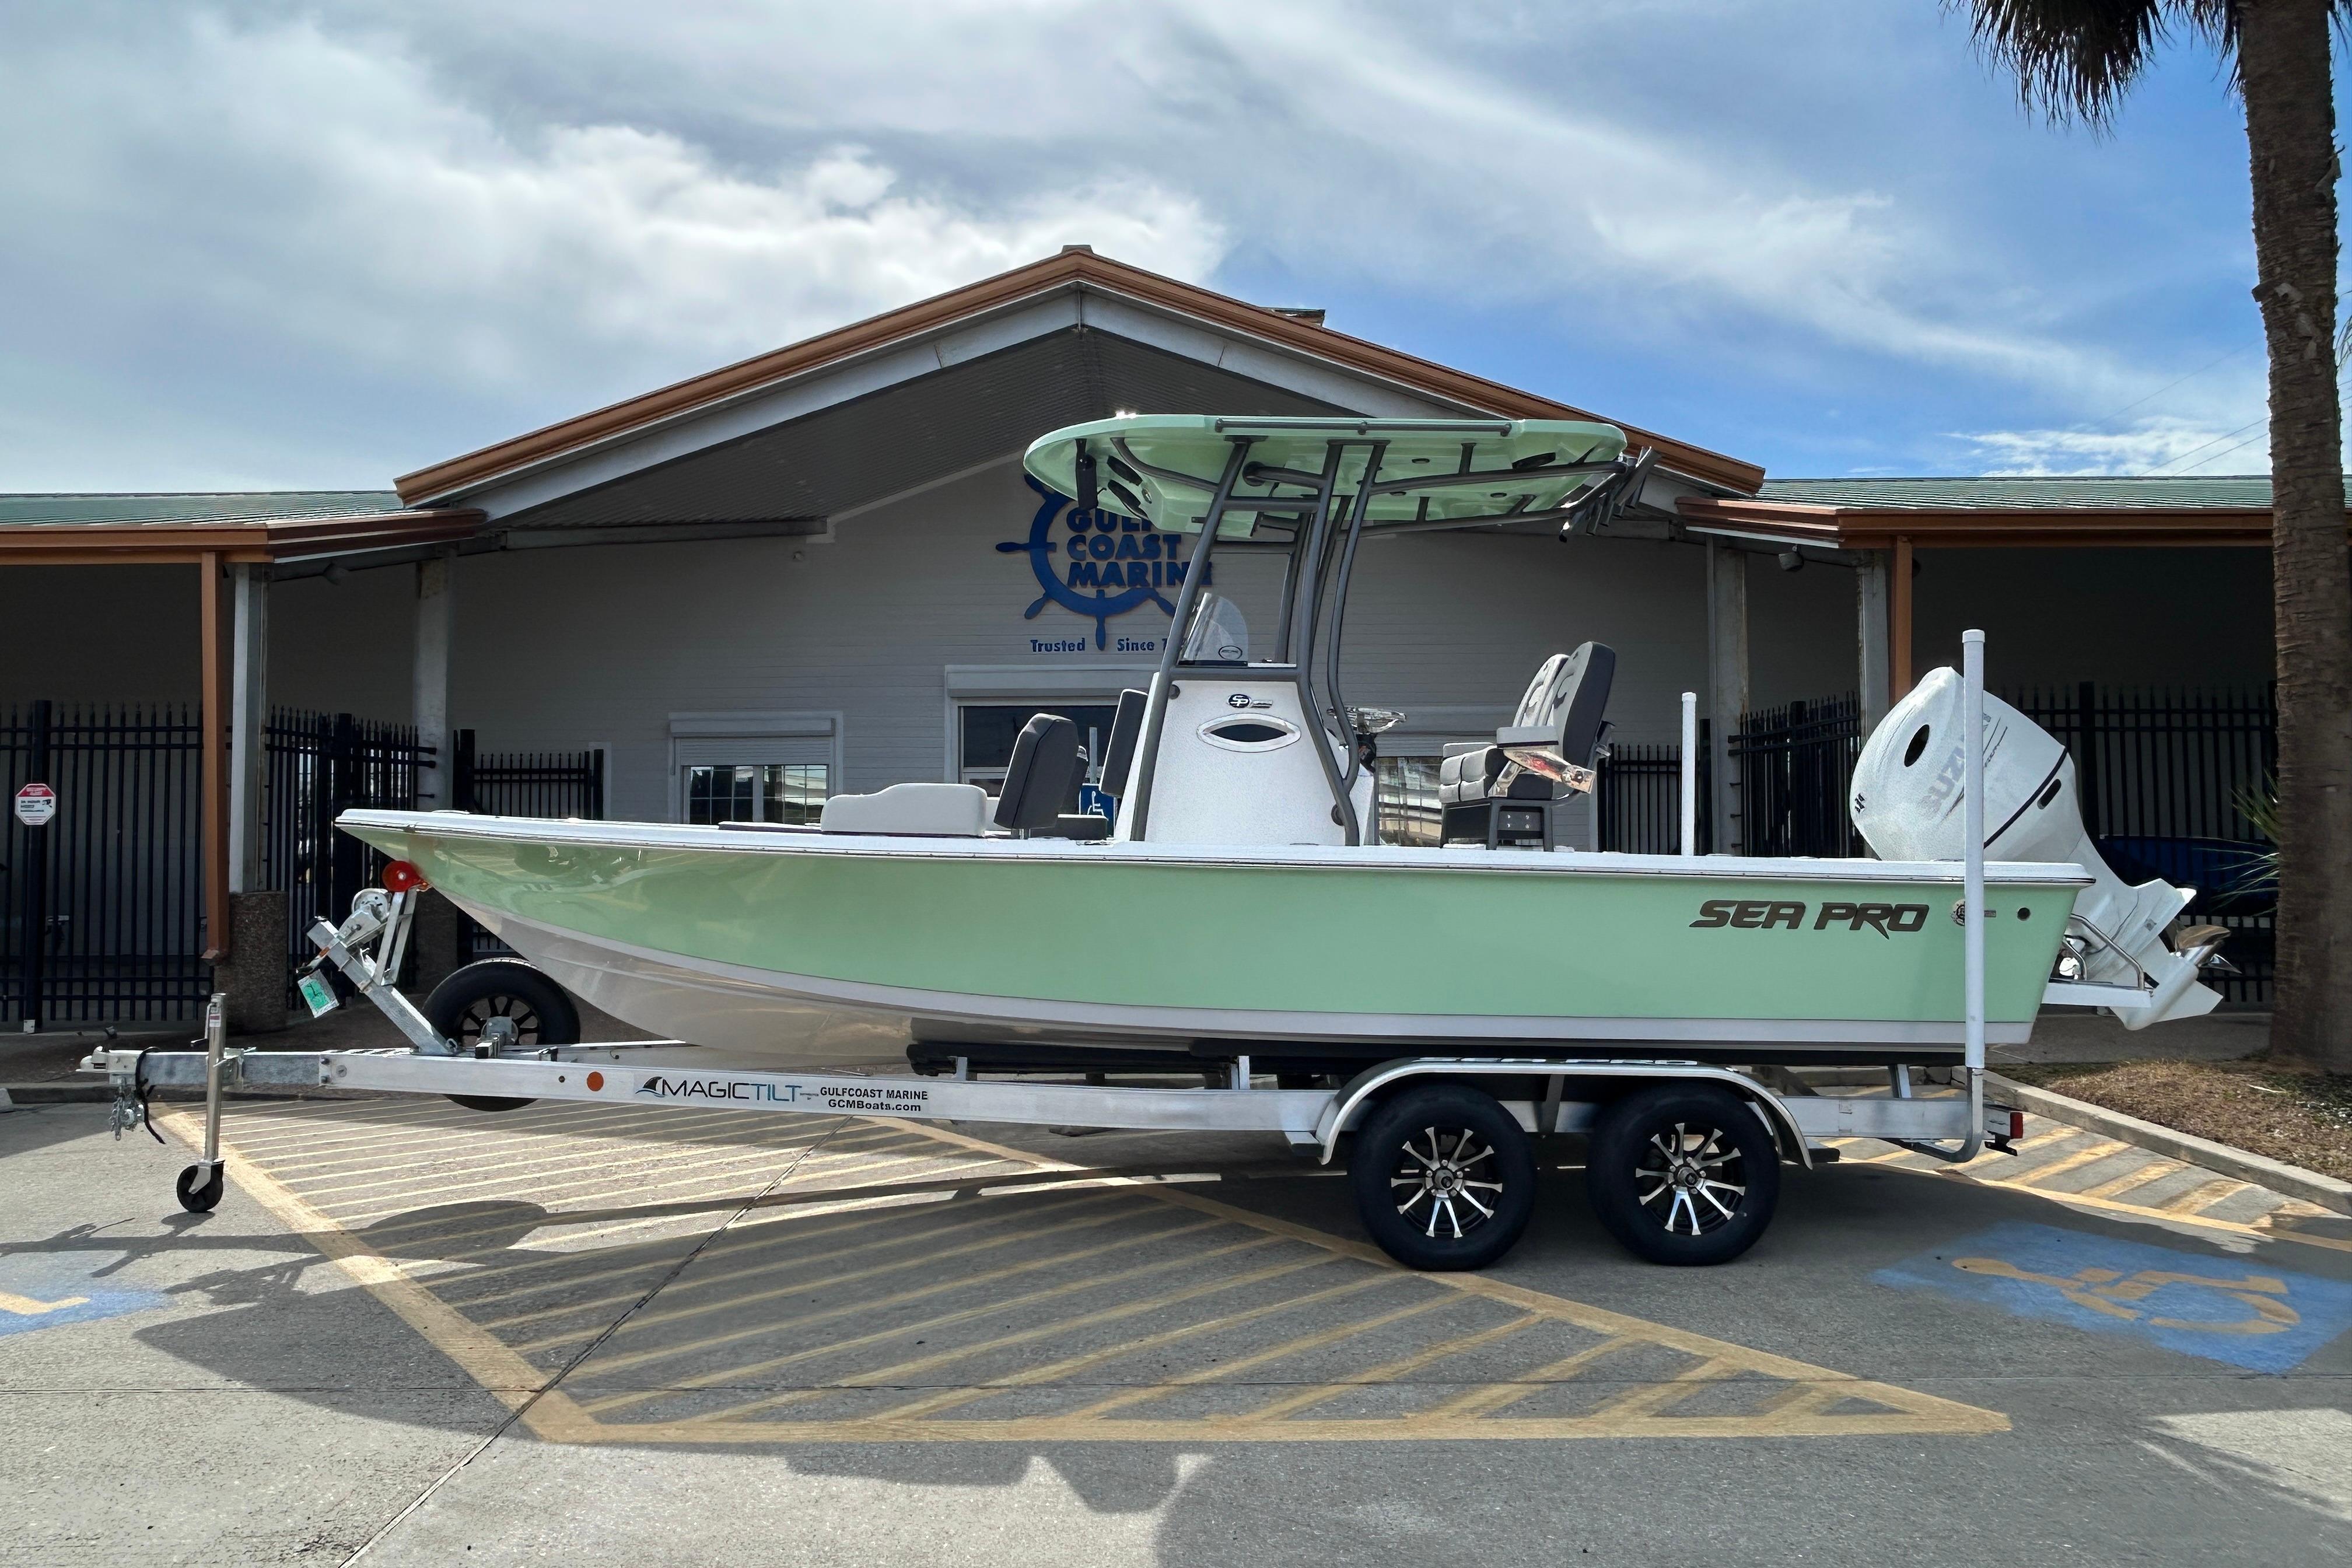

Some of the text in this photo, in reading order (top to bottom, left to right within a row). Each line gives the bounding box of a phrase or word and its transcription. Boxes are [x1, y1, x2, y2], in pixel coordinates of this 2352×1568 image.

[1066, 534, 1182, 561] COAST
[1030, 638, 1086, 652] Trusted
[1117, 638, 1154, 652] Since
[1689, 900, 1929, 940] SEA PRO
[662, 1079, 803, 1102] MAGICTILT
[820, 1087, 883, 1098] GULFCOAST
[886, 1089, 928, 1100] MARINE
[828, 1099, 921, 1112] GCMBoats.com
